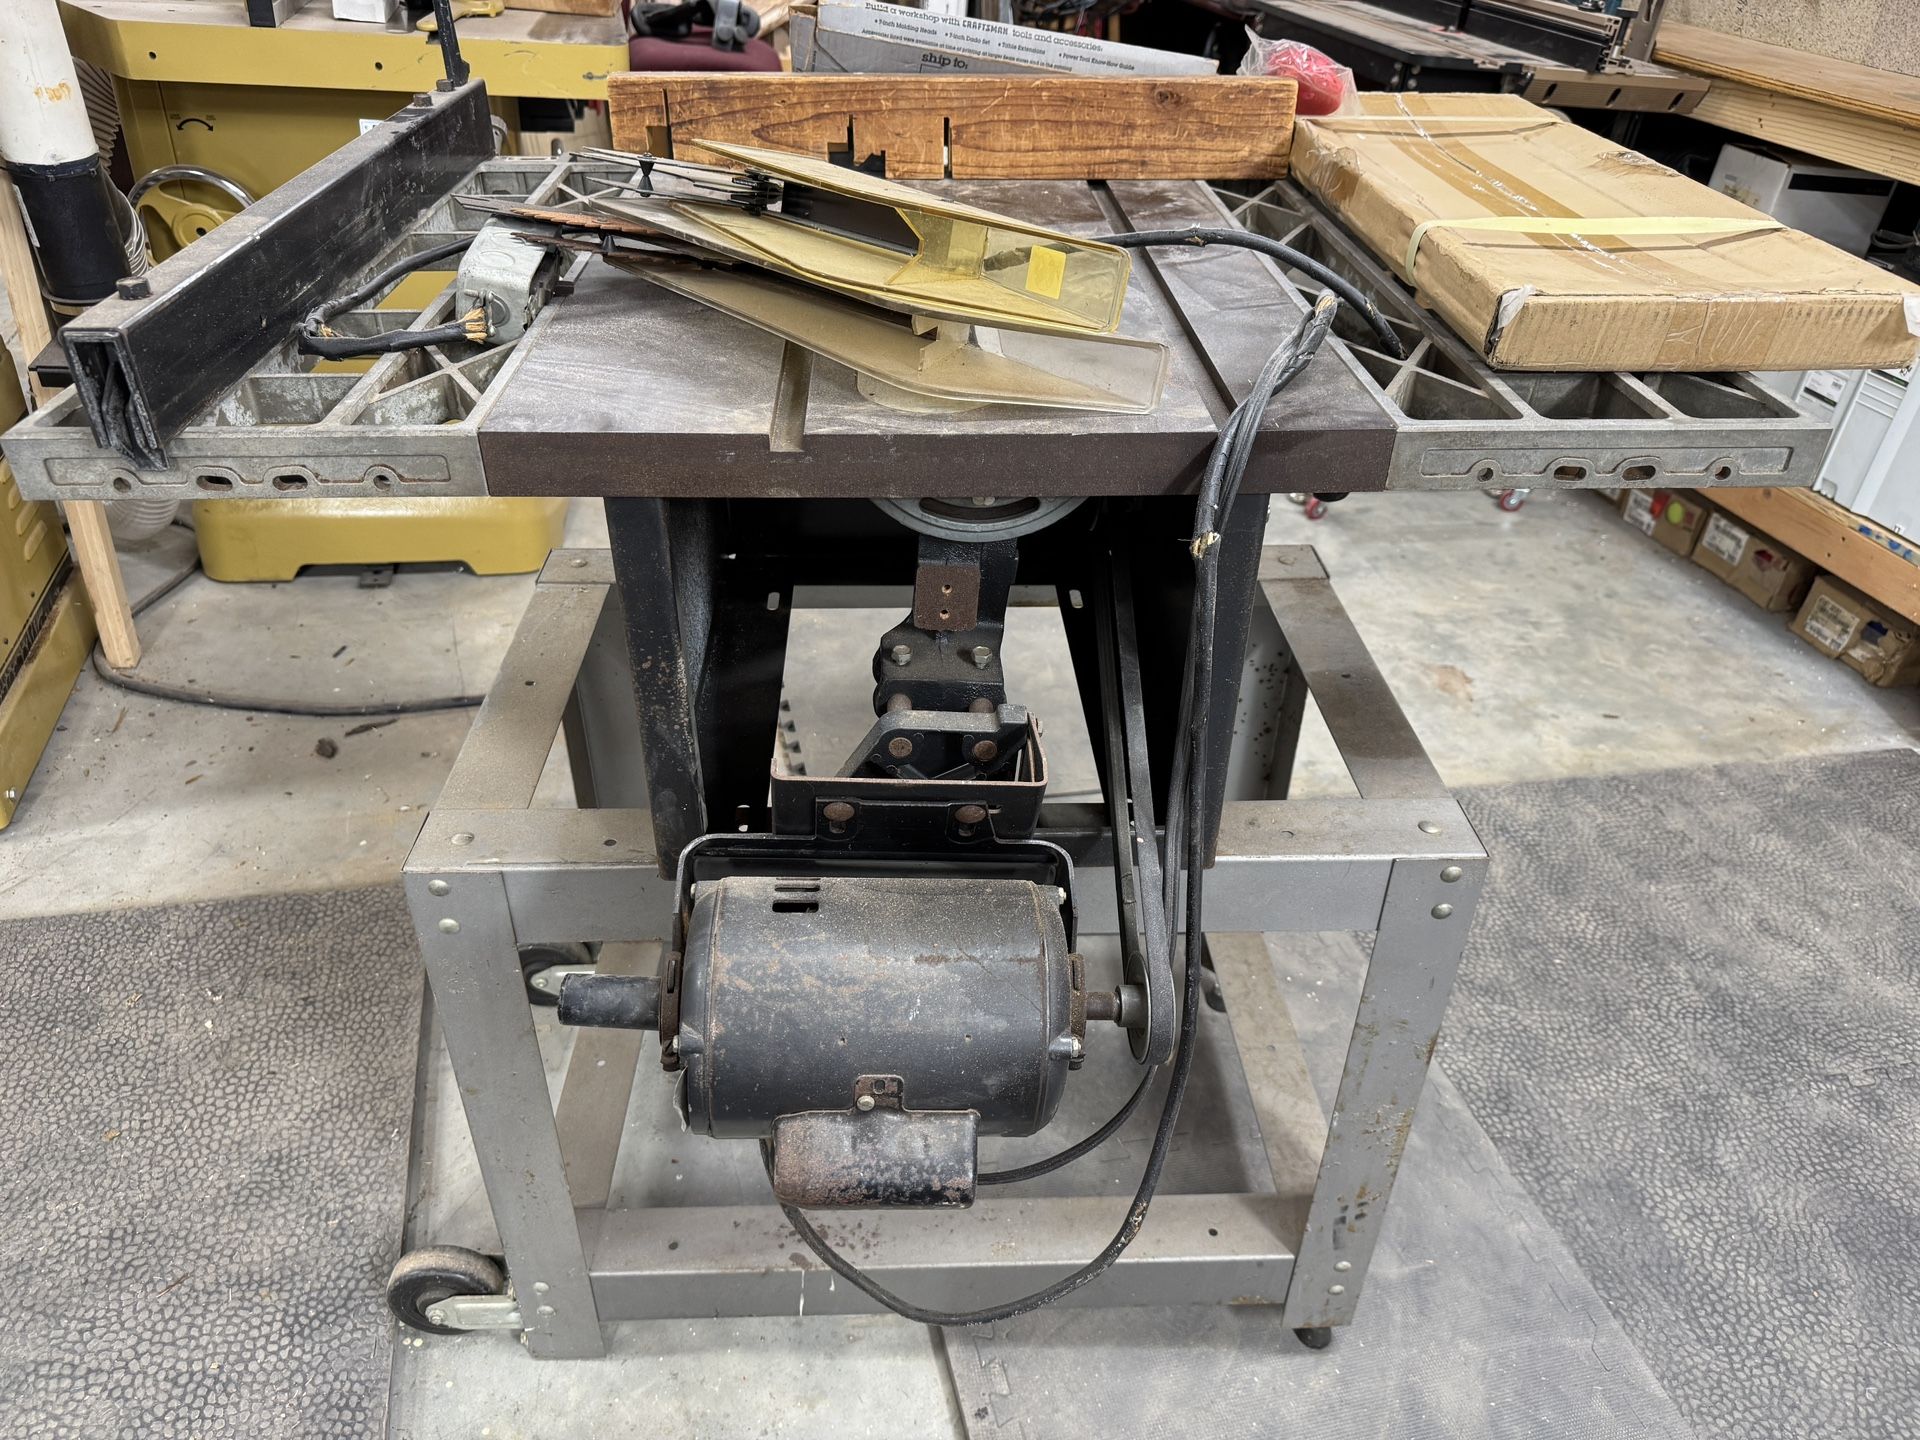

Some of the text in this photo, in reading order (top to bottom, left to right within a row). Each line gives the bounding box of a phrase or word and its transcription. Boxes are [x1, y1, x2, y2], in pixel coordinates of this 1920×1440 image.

[898, 9, 940, 24] workshop
[941, 16, 960, 26] with
[962, 20, 1008, 35] CRAFTSMAN
[1012, 29, 1032, 40] tools
[1034, 33, 1052, 43] and
[921, 52, 951, 66] ship
